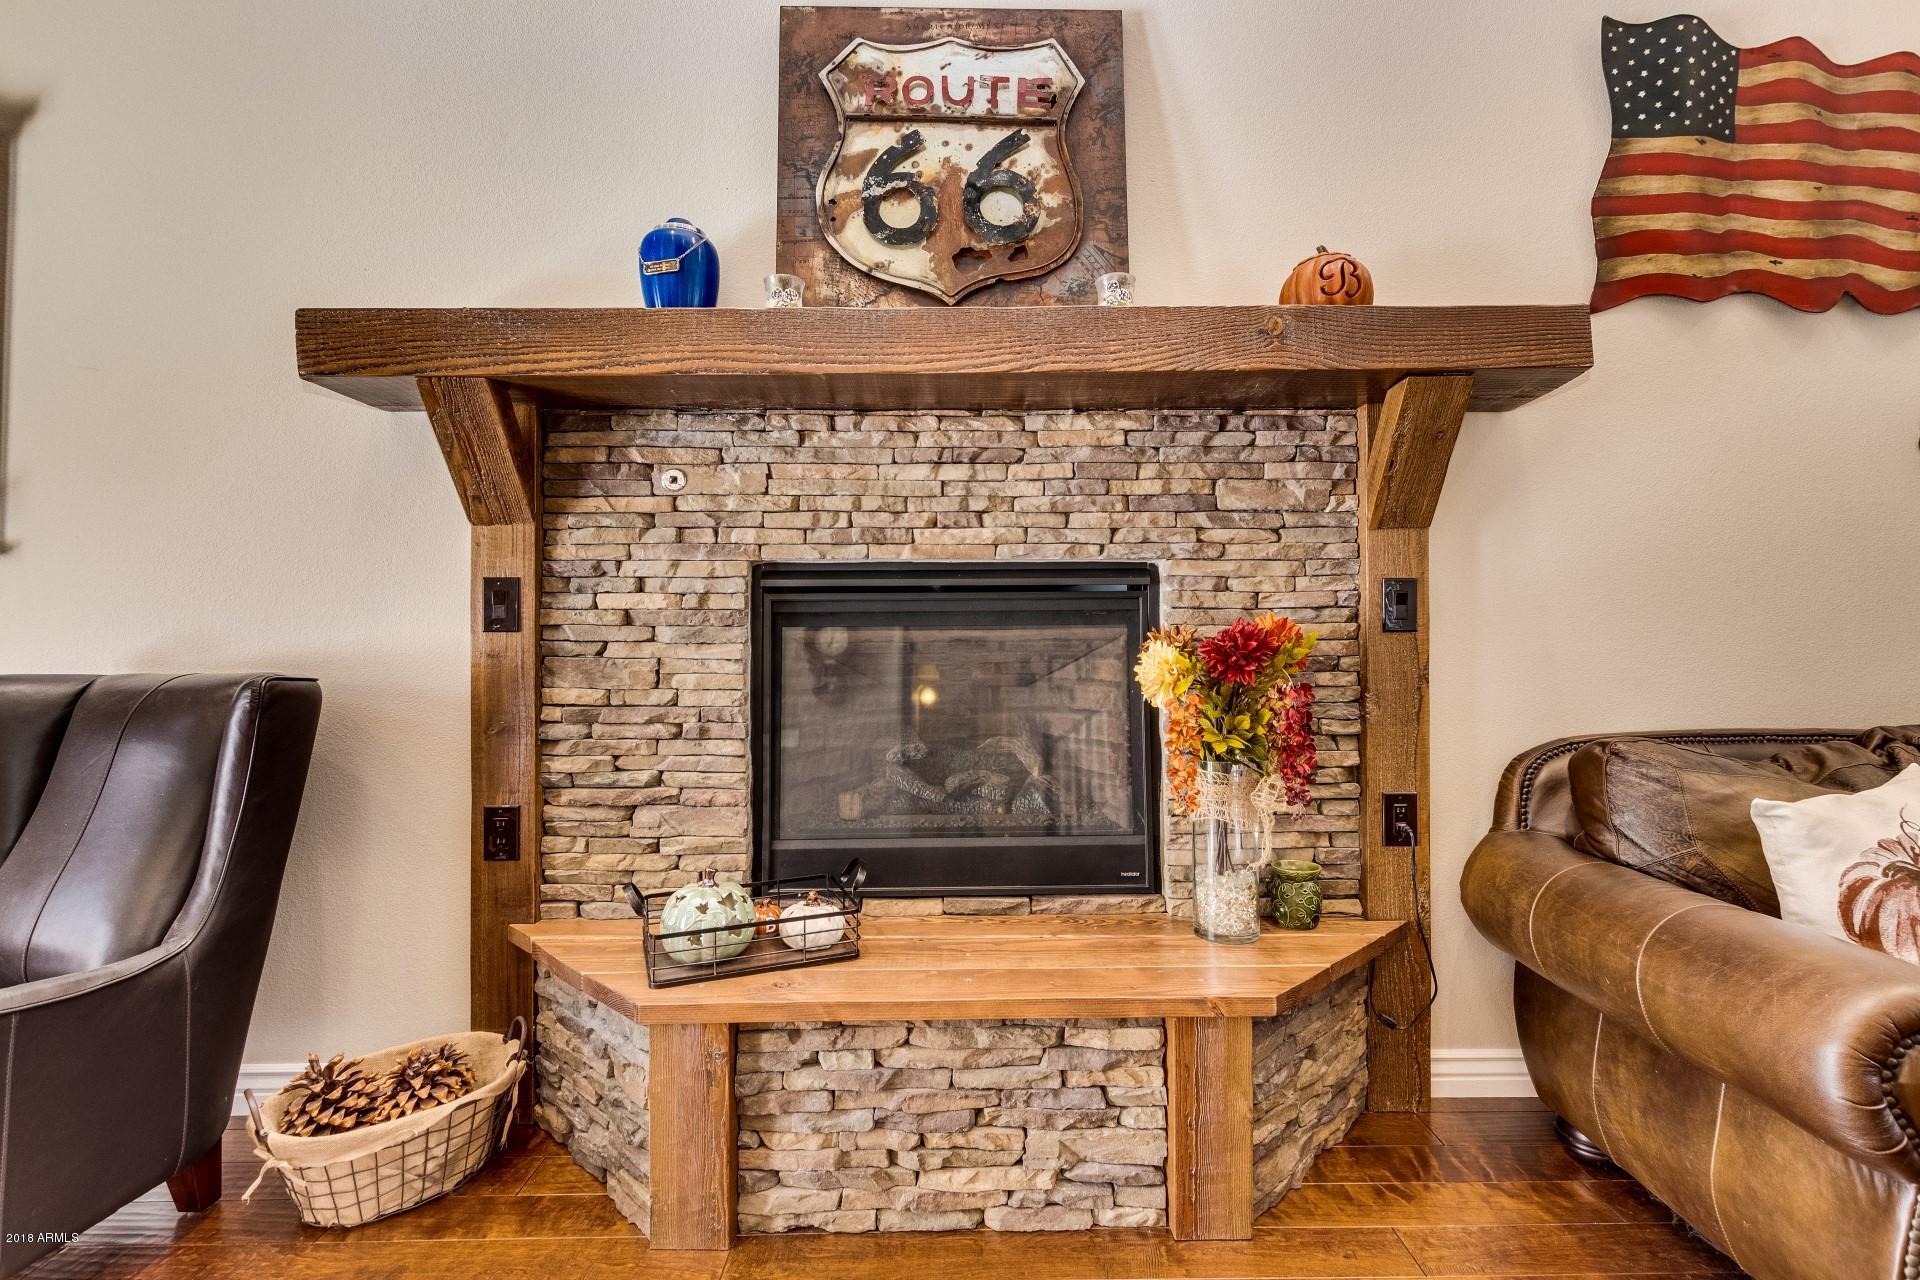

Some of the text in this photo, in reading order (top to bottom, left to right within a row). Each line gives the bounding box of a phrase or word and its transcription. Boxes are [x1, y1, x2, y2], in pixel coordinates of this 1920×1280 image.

[864, 75, 1053, 108] ROUTE
[861, 128, 1041, 246] 66
[1319, 257, 1362, 298] B
